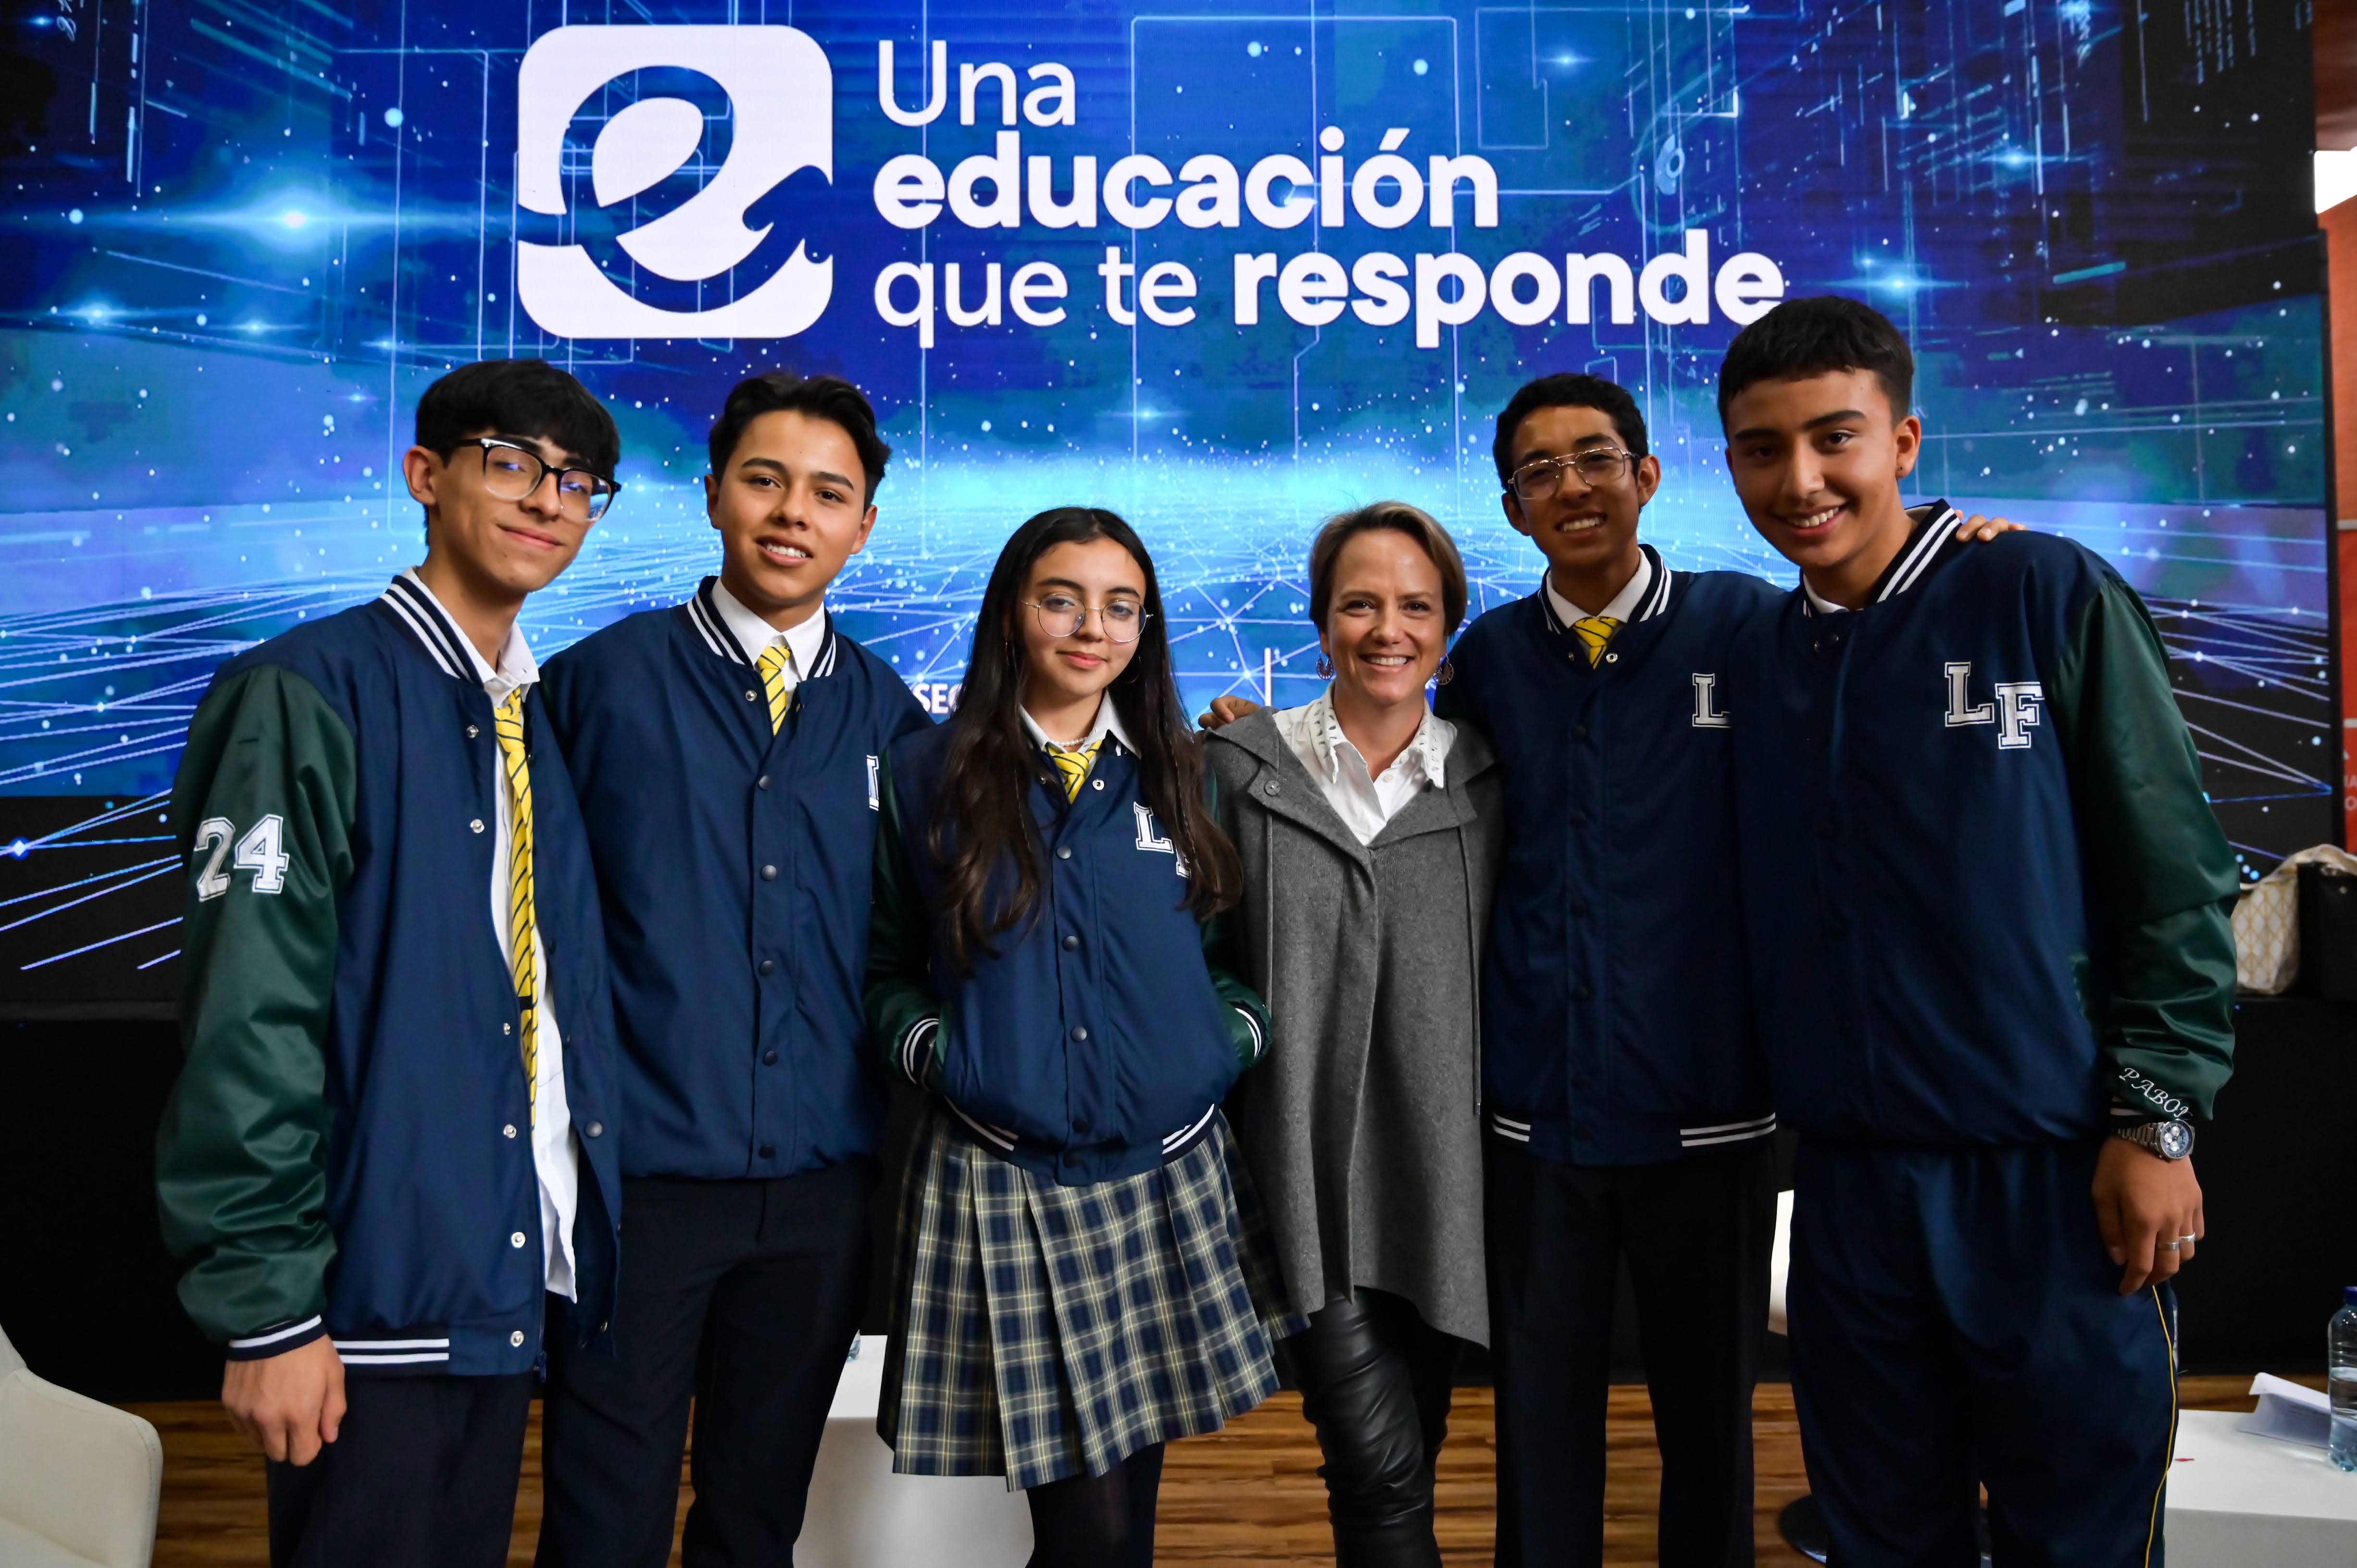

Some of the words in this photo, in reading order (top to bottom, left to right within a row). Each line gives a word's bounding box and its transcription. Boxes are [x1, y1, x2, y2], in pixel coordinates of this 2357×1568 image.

[879, 40, 1075, 126] Una
[874, 128, 1498, 228] educación
[874, 262, 1068, 348] que
[1098, 247, 1197, 325] te
[1235, 229, 1784, 348] responde
[194, 814, 289, 902] 24
